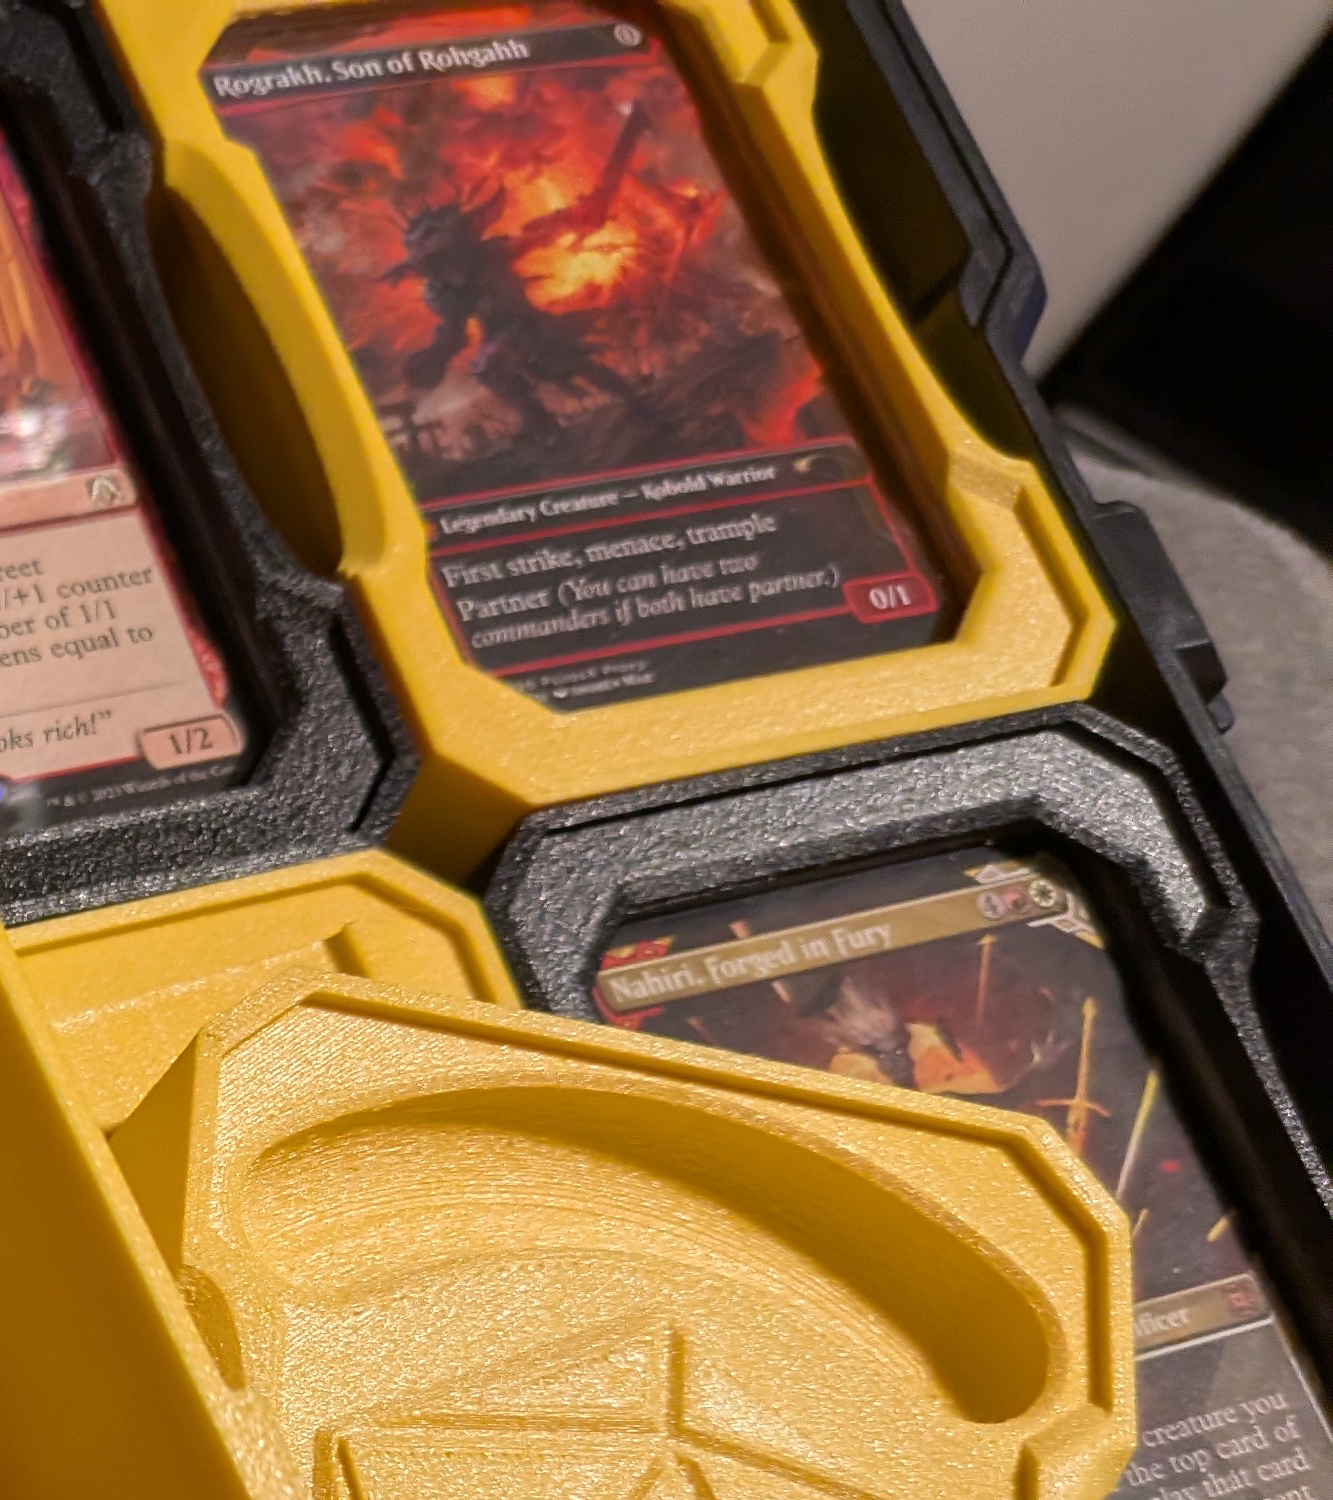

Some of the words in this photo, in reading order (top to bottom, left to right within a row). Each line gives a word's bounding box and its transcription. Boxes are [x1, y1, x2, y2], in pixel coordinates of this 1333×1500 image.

[332, 60, 381, 81] Son
[387, 52, 413, 74] of
[417, 39, 529, 72] Rohgahh
[440, 505, 536, 534] Legendary
[539, 492, 618, 516] Creature
[441, 561, 502, 588] First
[505, 547, 583, 577] strike,
[584, 532, 687, 562] menace,
[687, 513, 777, 545] trample
[56, 566, 153, 600] counter
[456, 589, 551, 621] Partner
[558, 578, 612, 607] (You
[616, 572, 656, 594] can
[660, 560, 714, 584] have
[869, 585, 910, 610] 0/1
[44, 606, 70, 630] of
[80, 599, 116, 625] 1/1
[472, 607, 611, 648] commanders
[614, 595, 631, 626] if
[635, 590, 686, 618] both
[51, 627, 120, 661] equal
[126, 625, 154, 645] to
[169, 727, 214, 756] 1/2
[704, 941, 797, 984] Forged
[800, 937, 828, 958] in
[830, 923, 891, 957] Fury
[1142, 1407, 1238, 1447] creature
[1240, 1393, 1289, 1424] you
[1126, 1462, 1166, 1486] the
[1169, 1449, 1213, 1474] top
[1215, 1425, 1269, 1459] card
[1274, 1414, 1301, 1442] of
[1203, 1469, 1254, 1497] that
[1257, 1446, 1312, 1481] card
